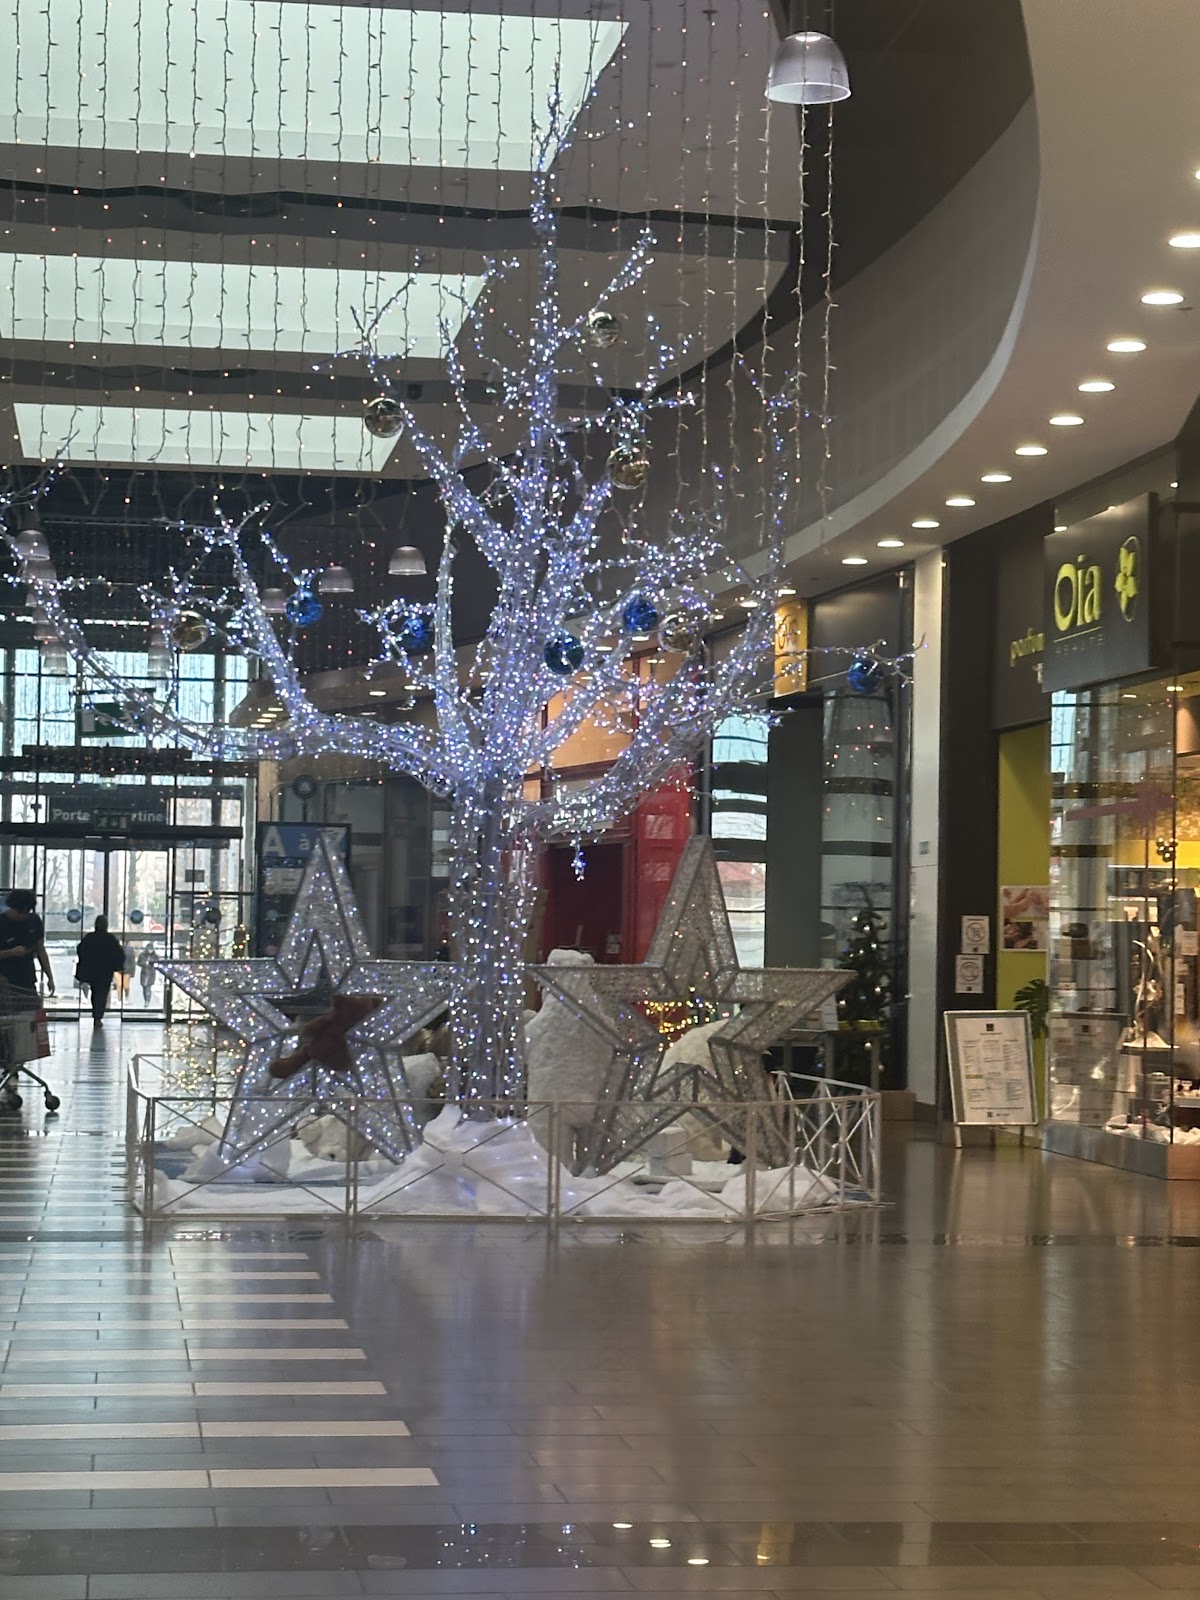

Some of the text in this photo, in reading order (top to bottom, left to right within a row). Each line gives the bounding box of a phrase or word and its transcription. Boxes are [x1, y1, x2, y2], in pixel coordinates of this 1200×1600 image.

[1054, 554, 1101, 631] Oia
[53, 808, 91, 821] Porte
[262, 826, 286, 857] A
